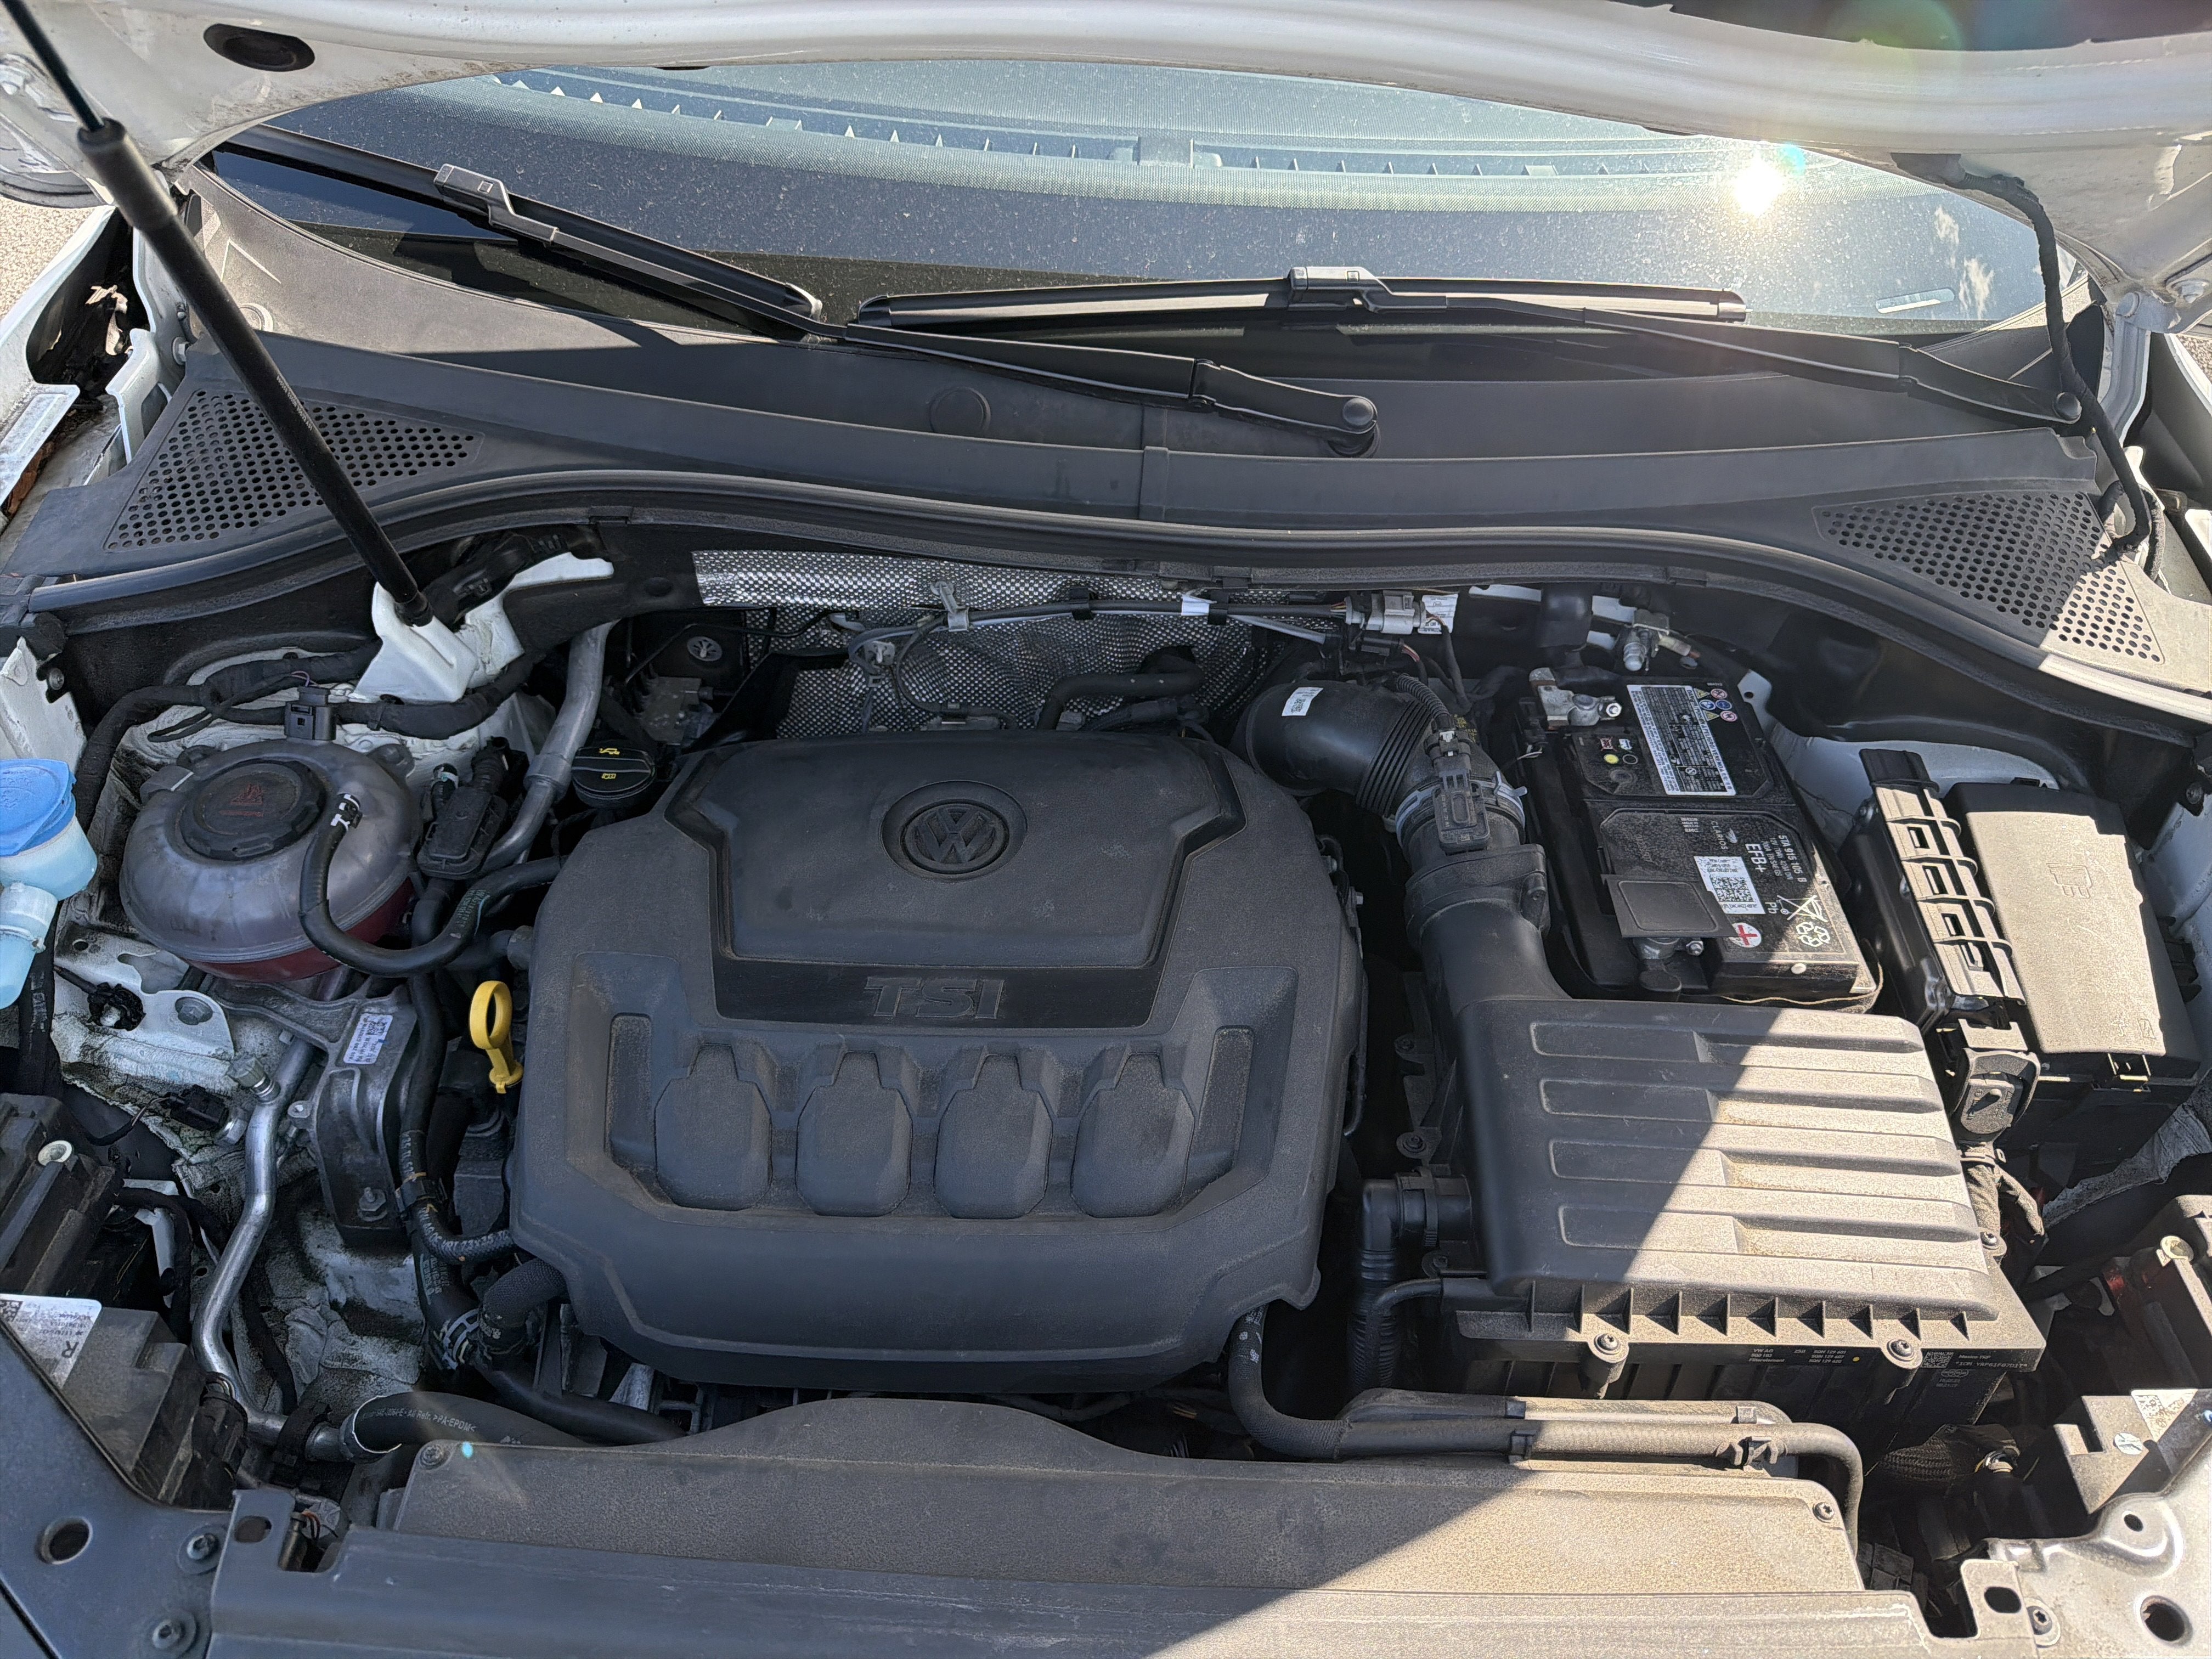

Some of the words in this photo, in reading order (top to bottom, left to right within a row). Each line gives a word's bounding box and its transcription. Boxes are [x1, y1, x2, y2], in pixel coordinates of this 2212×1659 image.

[1711, 821, 1728, 850] CLARIOS
[1779, 835, 1791, 847] 5TA
[1745, 843, 1768, 873] EFB+
[1784, 848, 1797, 860] 915
[1791, 862, 1804, 873] 105
[1765, 901, 1779, 915] Pb
[864, 977, 1006, 1019] TSI
[61, 1340, 79, 1358] R
